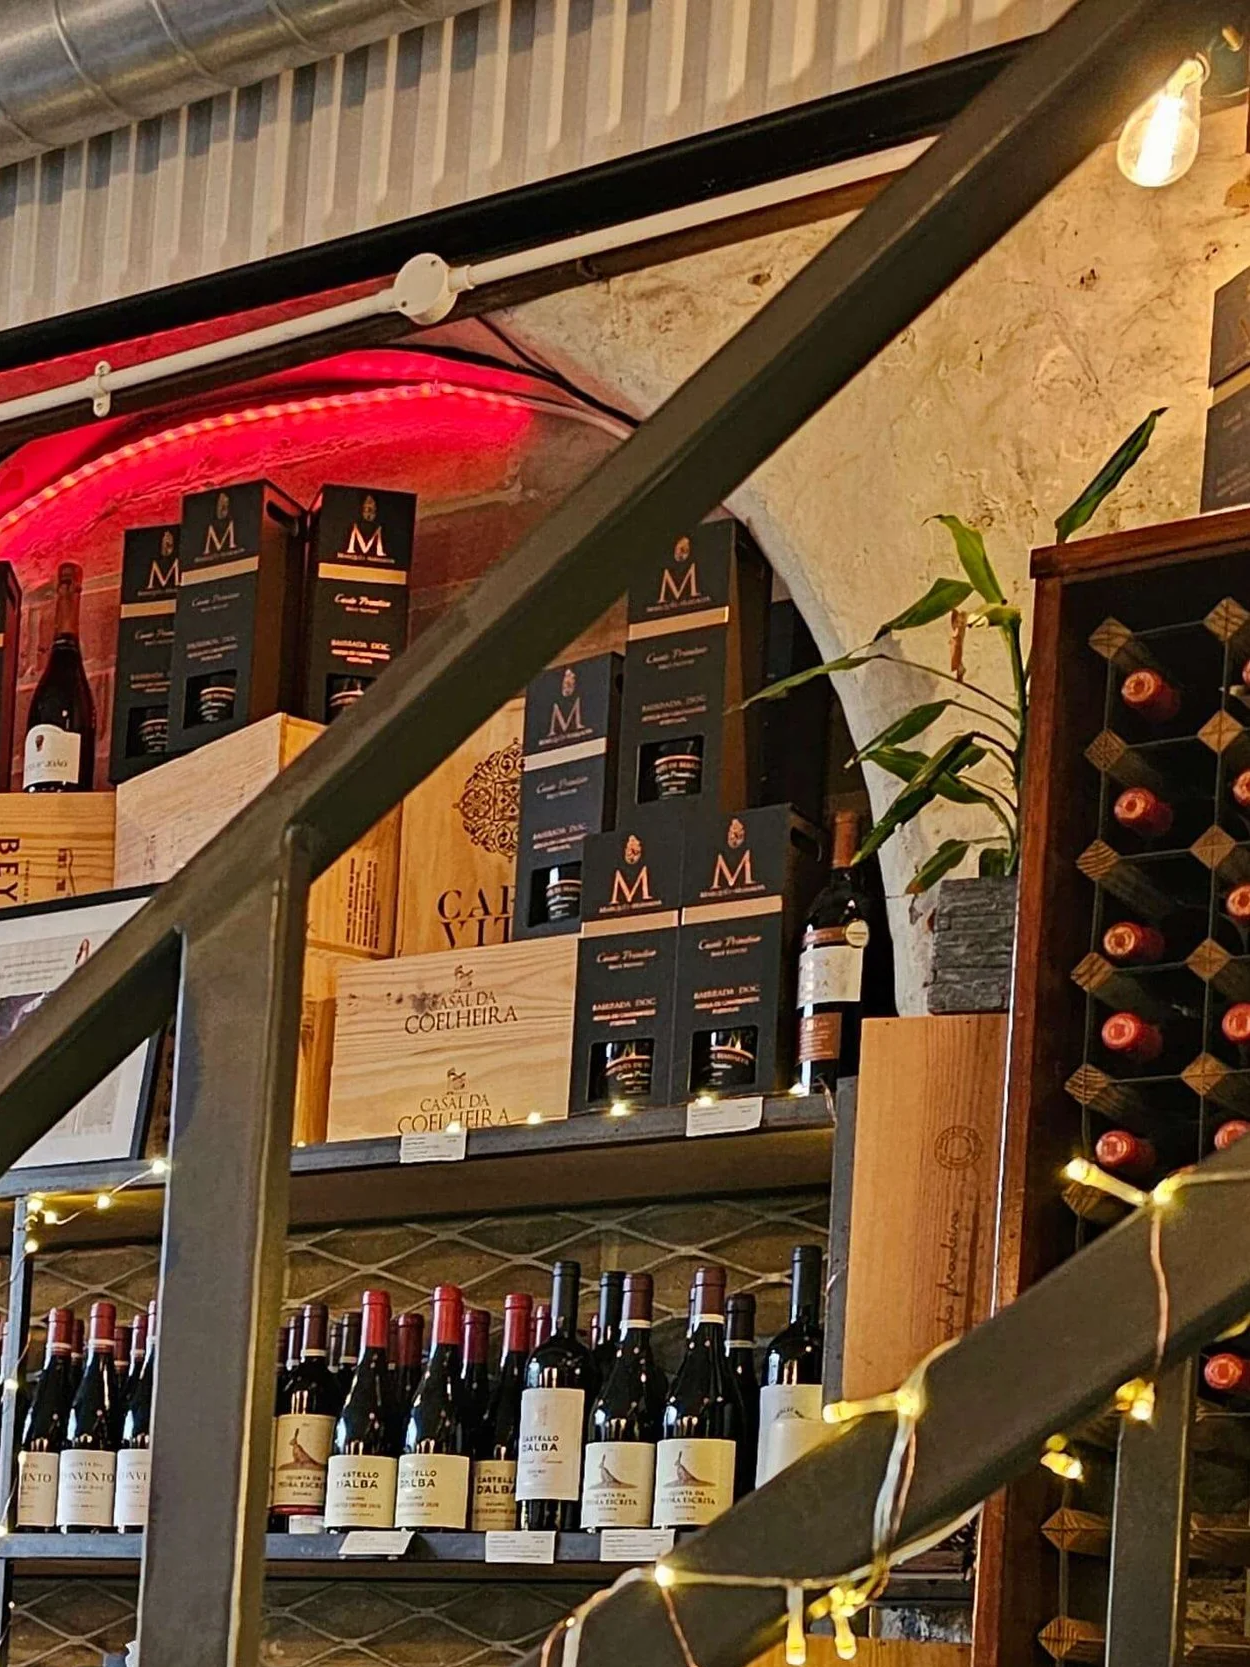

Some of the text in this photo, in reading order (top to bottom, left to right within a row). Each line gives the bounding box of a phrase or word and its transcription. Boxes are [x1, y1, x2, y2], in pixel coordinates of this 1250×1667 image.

[204, 520, 237, 554] M
[347, 523, 386, 556] M
[147, 558, 180, 589] M
[658, 563, 700, 603] M
[547, 697, 586, 736] M
[610, 865, 653, 904] M
[712, 849, 755, 888] M
[428, 991, 496, 1011] CASAL DA
[405, 1005, 518, 1034] COELHEIRA
[420, 1094, 490, 1113] CASAL DA
[477, 1476, 516, 1484] CASTELL
